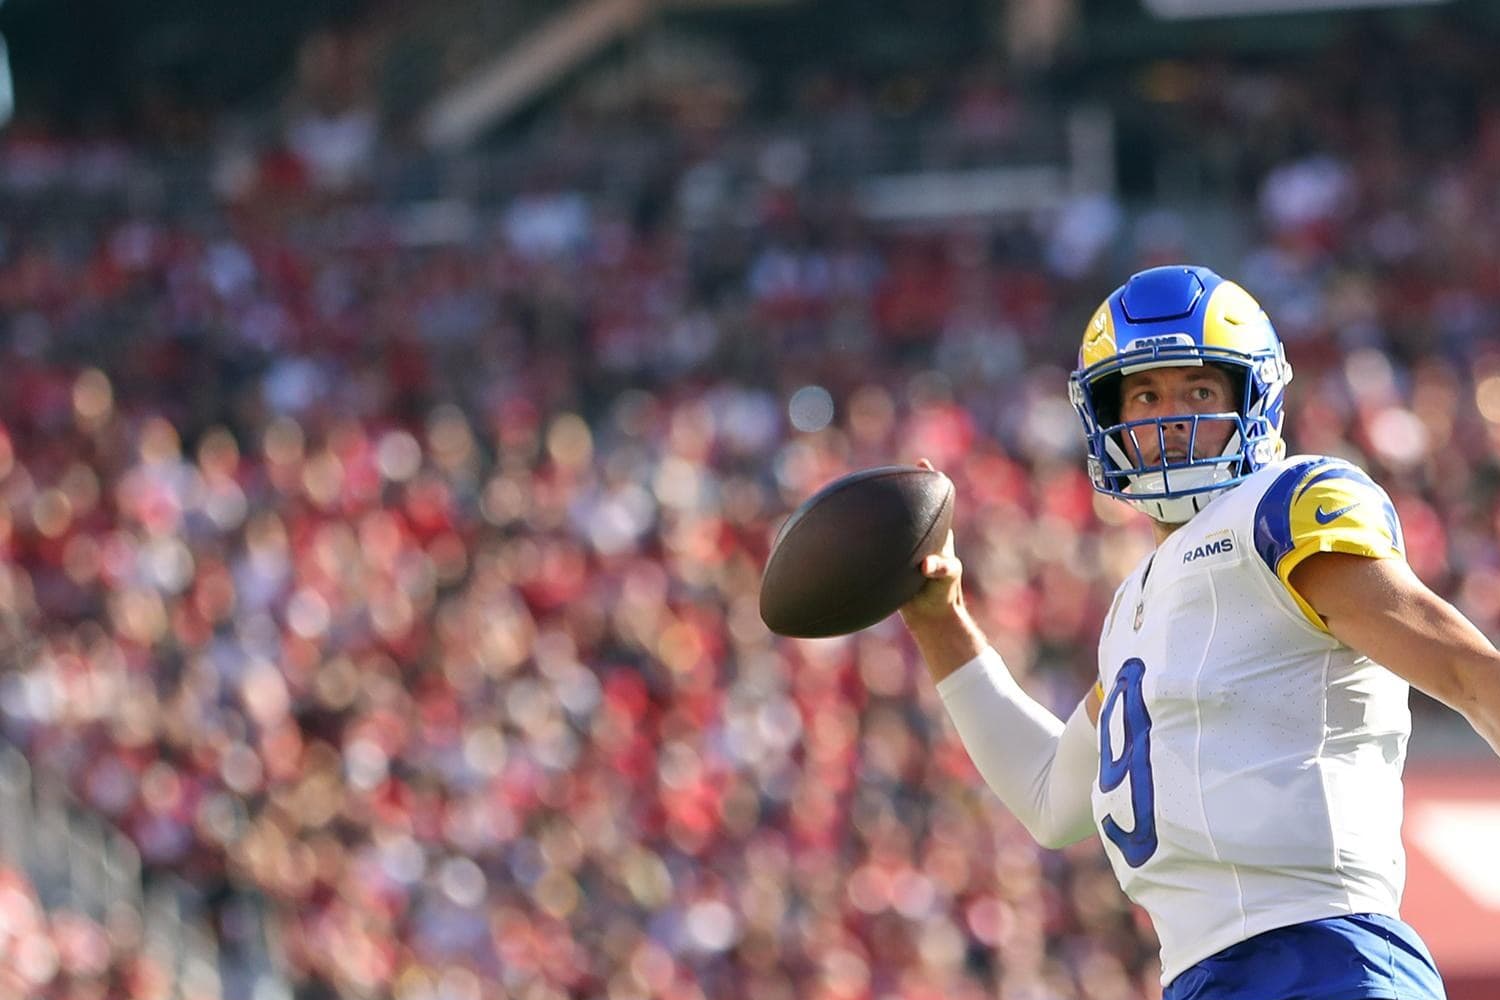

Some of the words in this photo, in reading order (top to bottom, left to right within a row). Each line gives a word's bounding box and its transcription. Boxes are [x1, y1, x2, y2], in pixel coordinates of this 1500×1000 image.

[1135, 336, 1177, 348] RAMS
[1183, 538, 1233, 564] RAMS
[1100, 657, 1159, 868] 9
